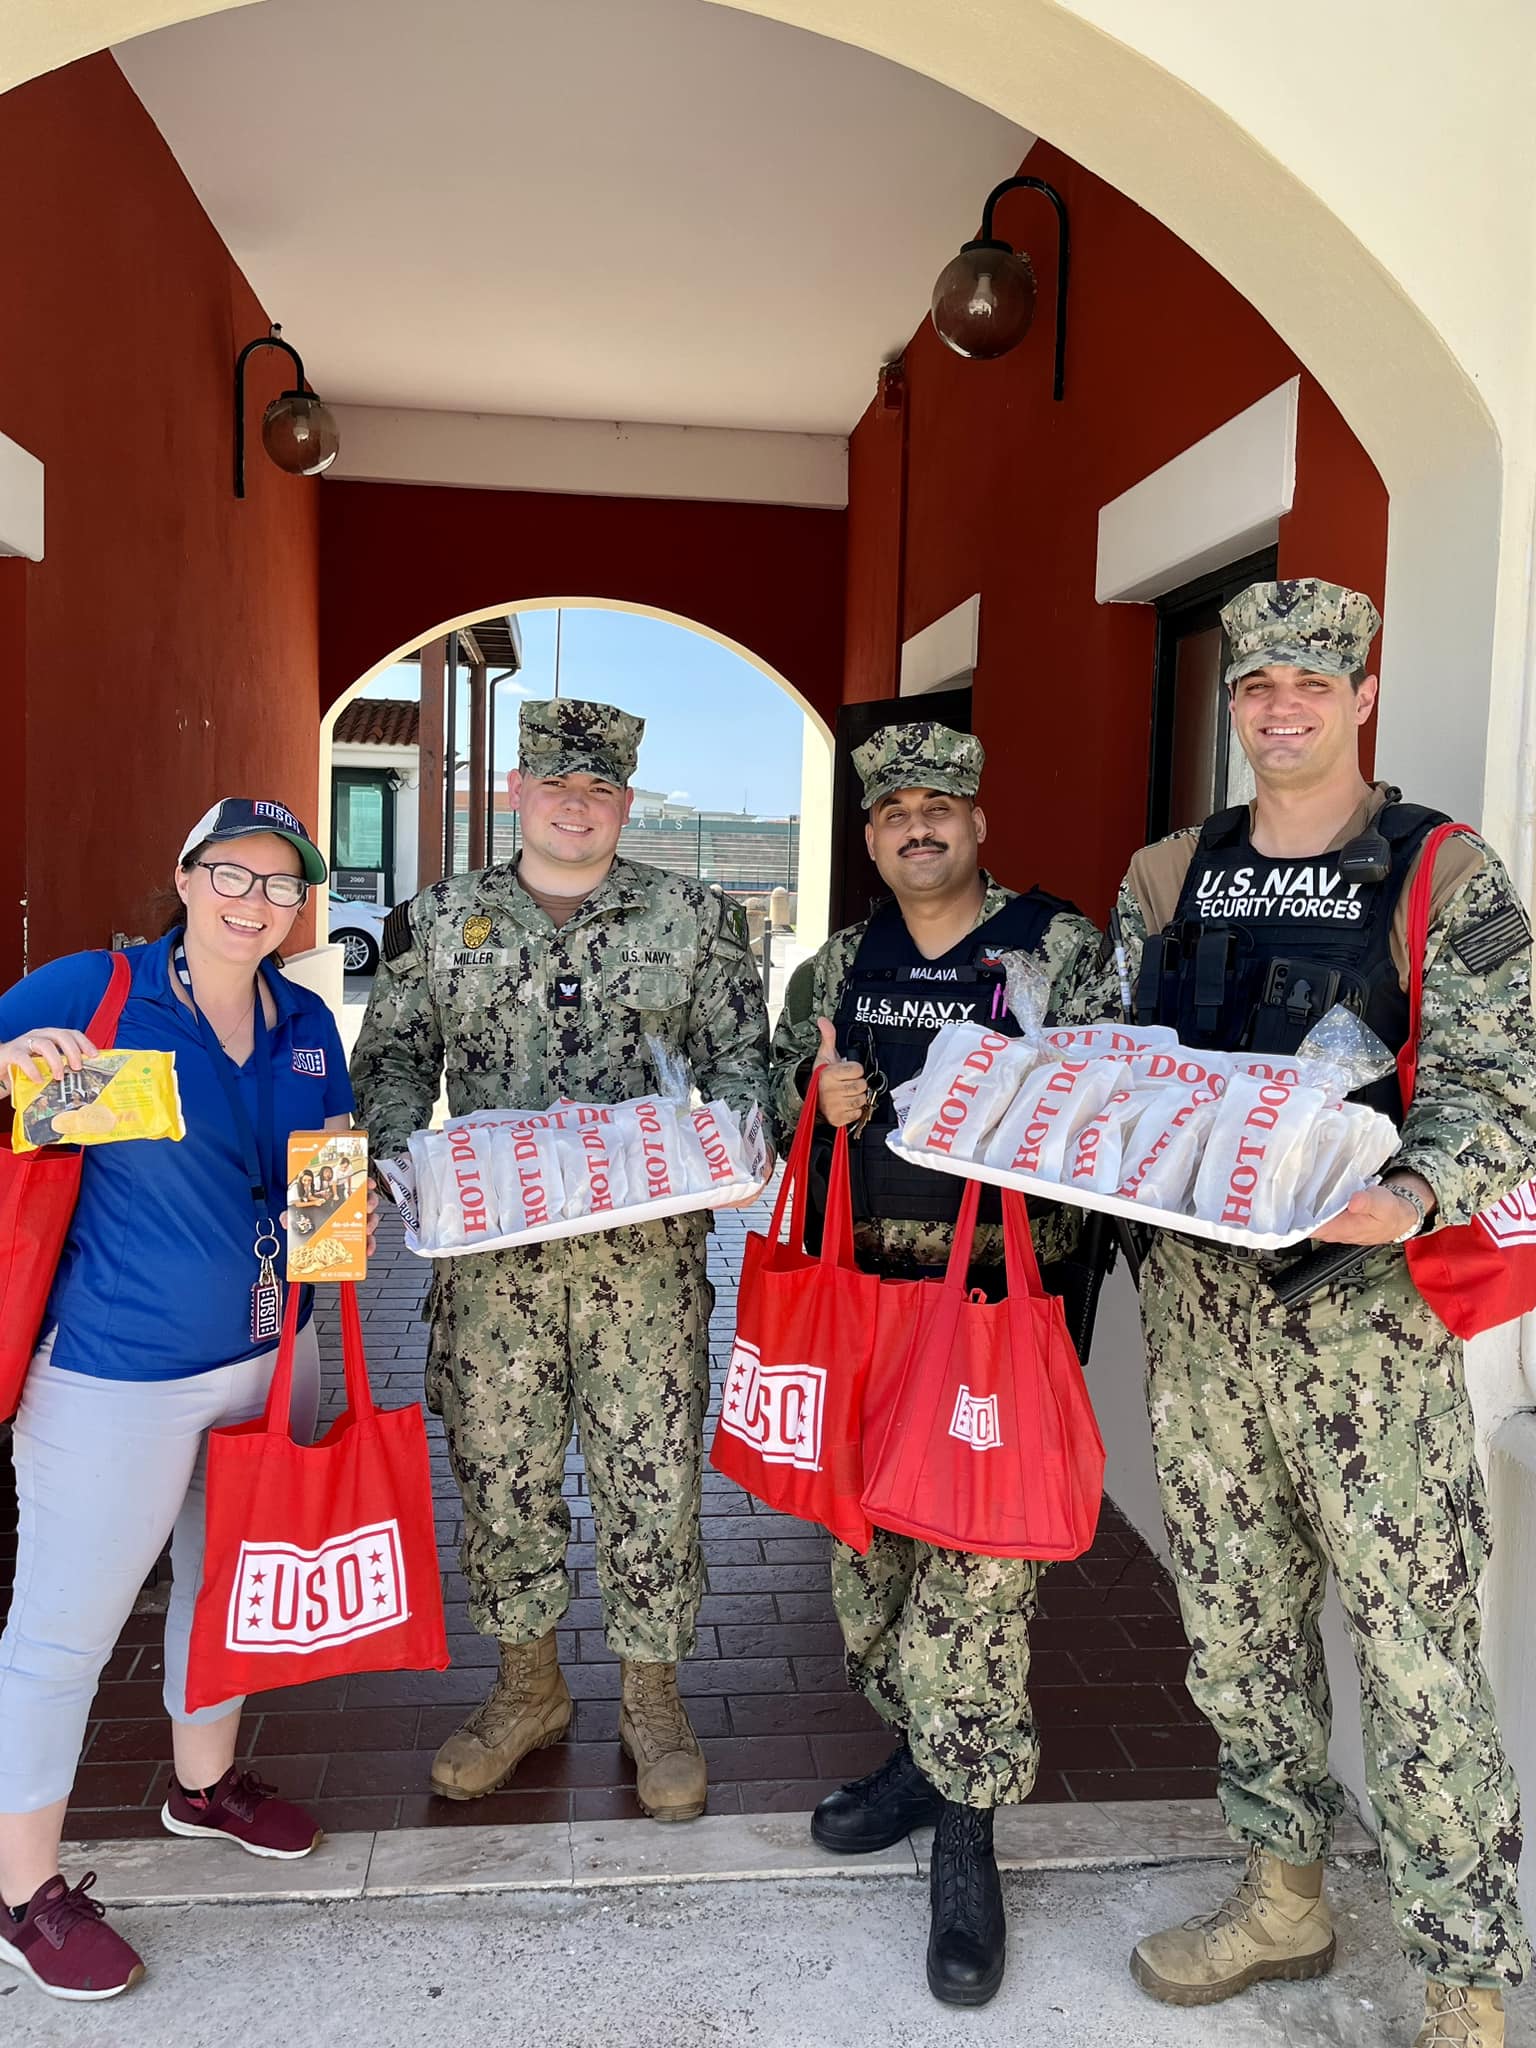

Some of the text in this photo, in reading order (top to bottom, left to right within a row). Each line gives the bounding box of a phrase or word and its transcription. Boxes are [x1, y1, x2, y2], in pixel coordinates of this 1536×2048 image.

[265, 804, 293, 827] USO
[622, 818, 683, 830] ATS
[1195, 897, 1362, 920] ECURITY FORCES
[453, 952, 494, 966] MILLER
[622, 951, 671, 964] U.S. NAVY
[910, 967, 958, 981] MALAVA
[855, 1012, 915, 1027] SECURITY
[1046, 1030, 1103, 1049] OT
[926, 1031, 1009, 1154] HOT DO
[635, 1101, 672, 1198] HOT DO
[699, 1130, 734, 1181] HOT
[1011, 1097, 1060, 1173] HOT
[1220, 1081, 1291, 1226] HOT DO
[448, 1128, 487, 1233] HOT DO
[511, 1127, 549, 1228] HOT DO
[586, 1154, 614, 1215] HOT
[259, 1297, 277, 1329] USO
[271, 1552, 365, 1633] USO
